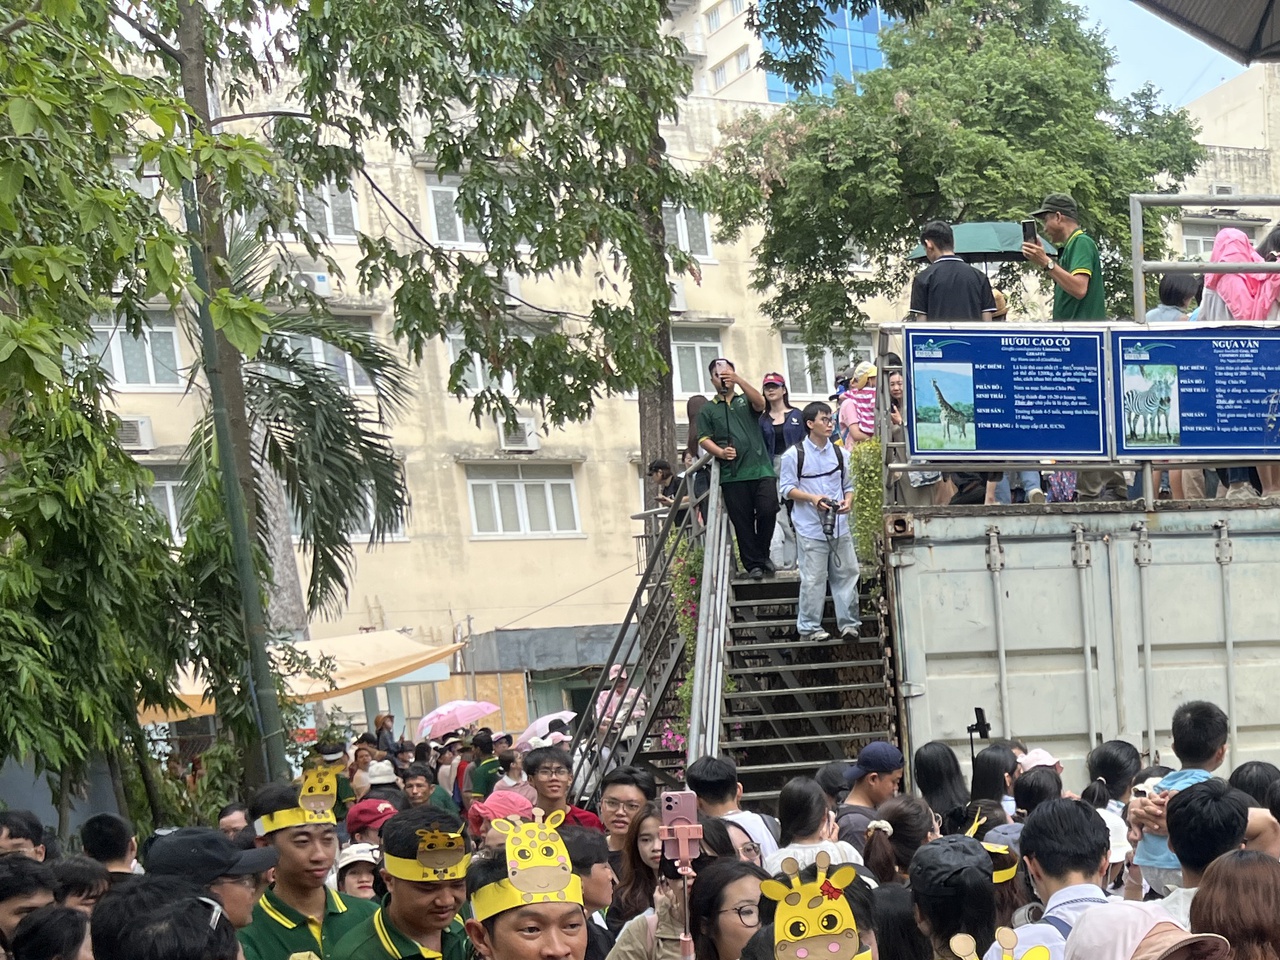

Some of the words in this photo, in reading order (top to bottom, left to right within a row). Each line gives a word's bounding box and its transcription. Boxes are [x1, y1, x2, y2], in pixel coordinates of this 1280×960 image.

[1001, 337, 1030, 346] HƯƠU
[1032, 338, 1054, 346] CAO
[1055, 336, 1071, 346] CỔ
[1212, 340, 1239, 349] NGỰA
